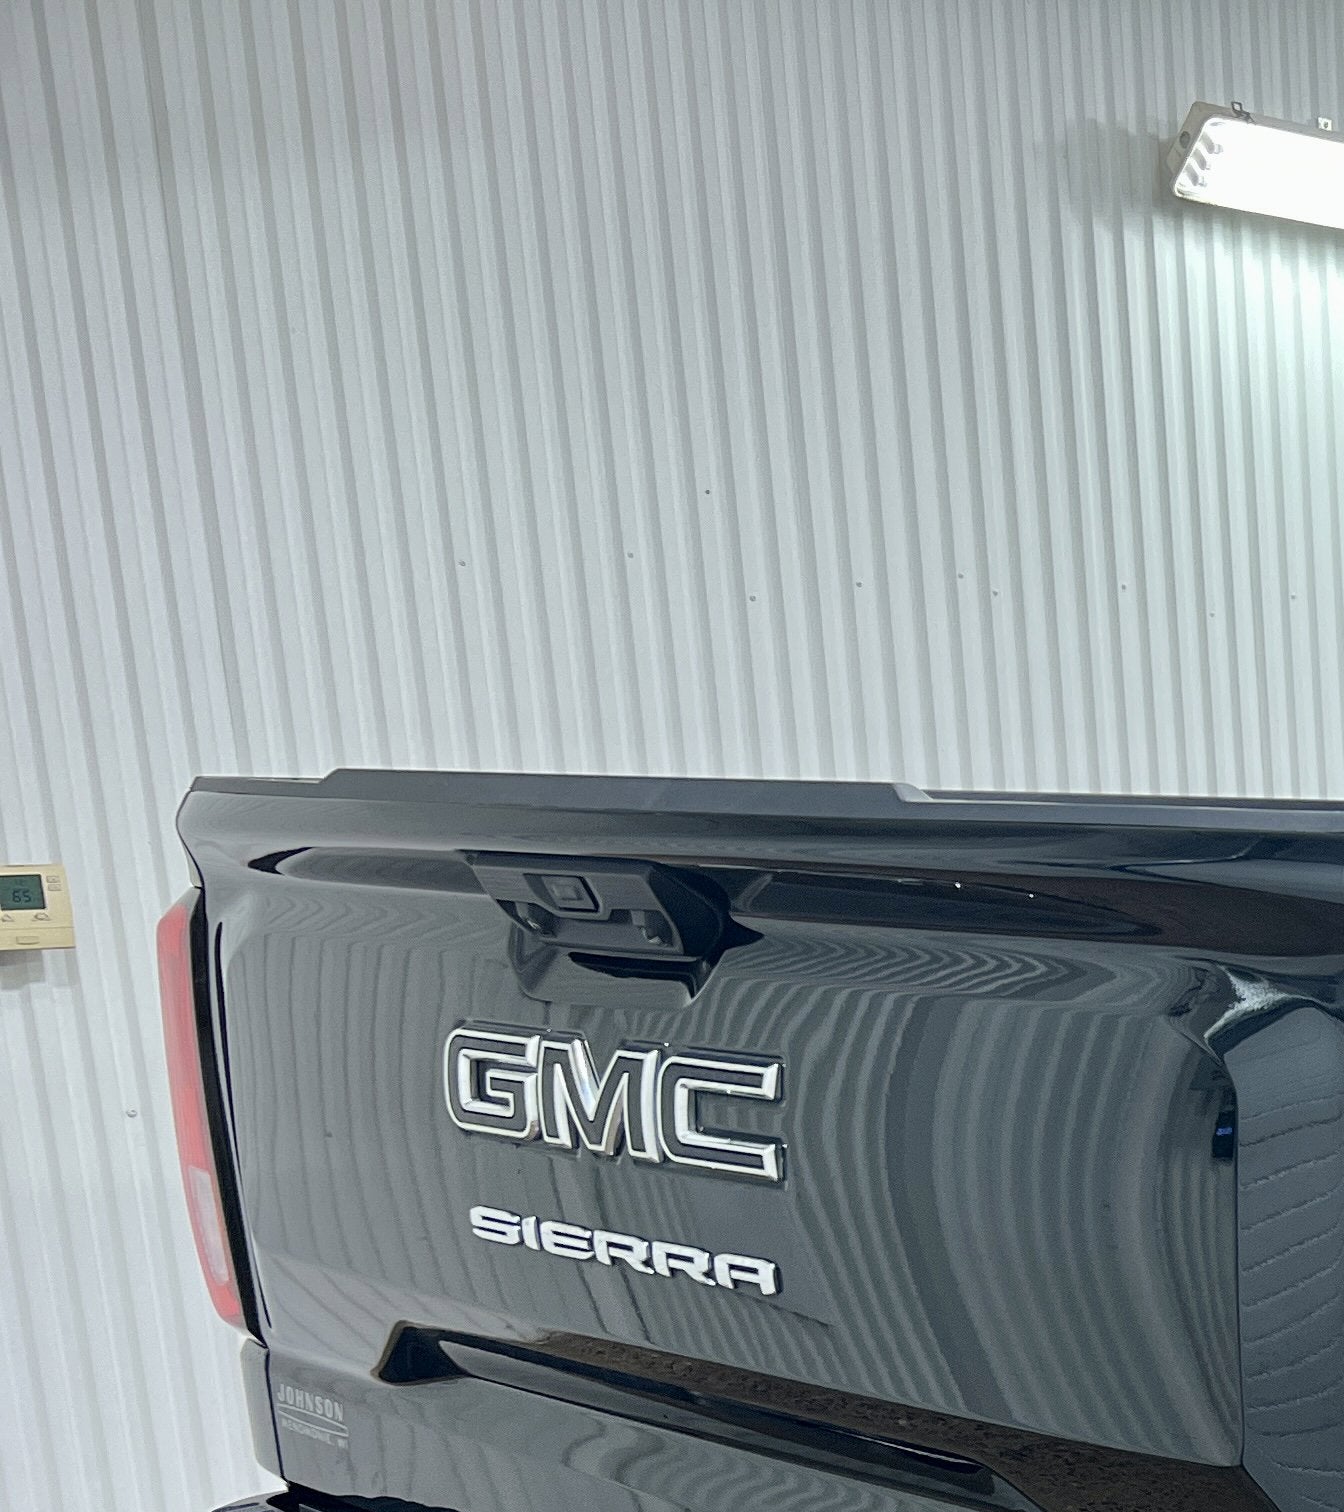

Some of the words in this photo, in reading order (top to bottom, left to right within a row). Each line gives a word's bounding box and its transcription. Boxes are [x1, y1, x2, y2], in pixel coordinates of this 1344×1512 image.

[444, 1028, 785, 1184] GMC
[469, 1205, 782, 1297] SIERRA
[277, 1383, 344, 1422] JOHNSON
